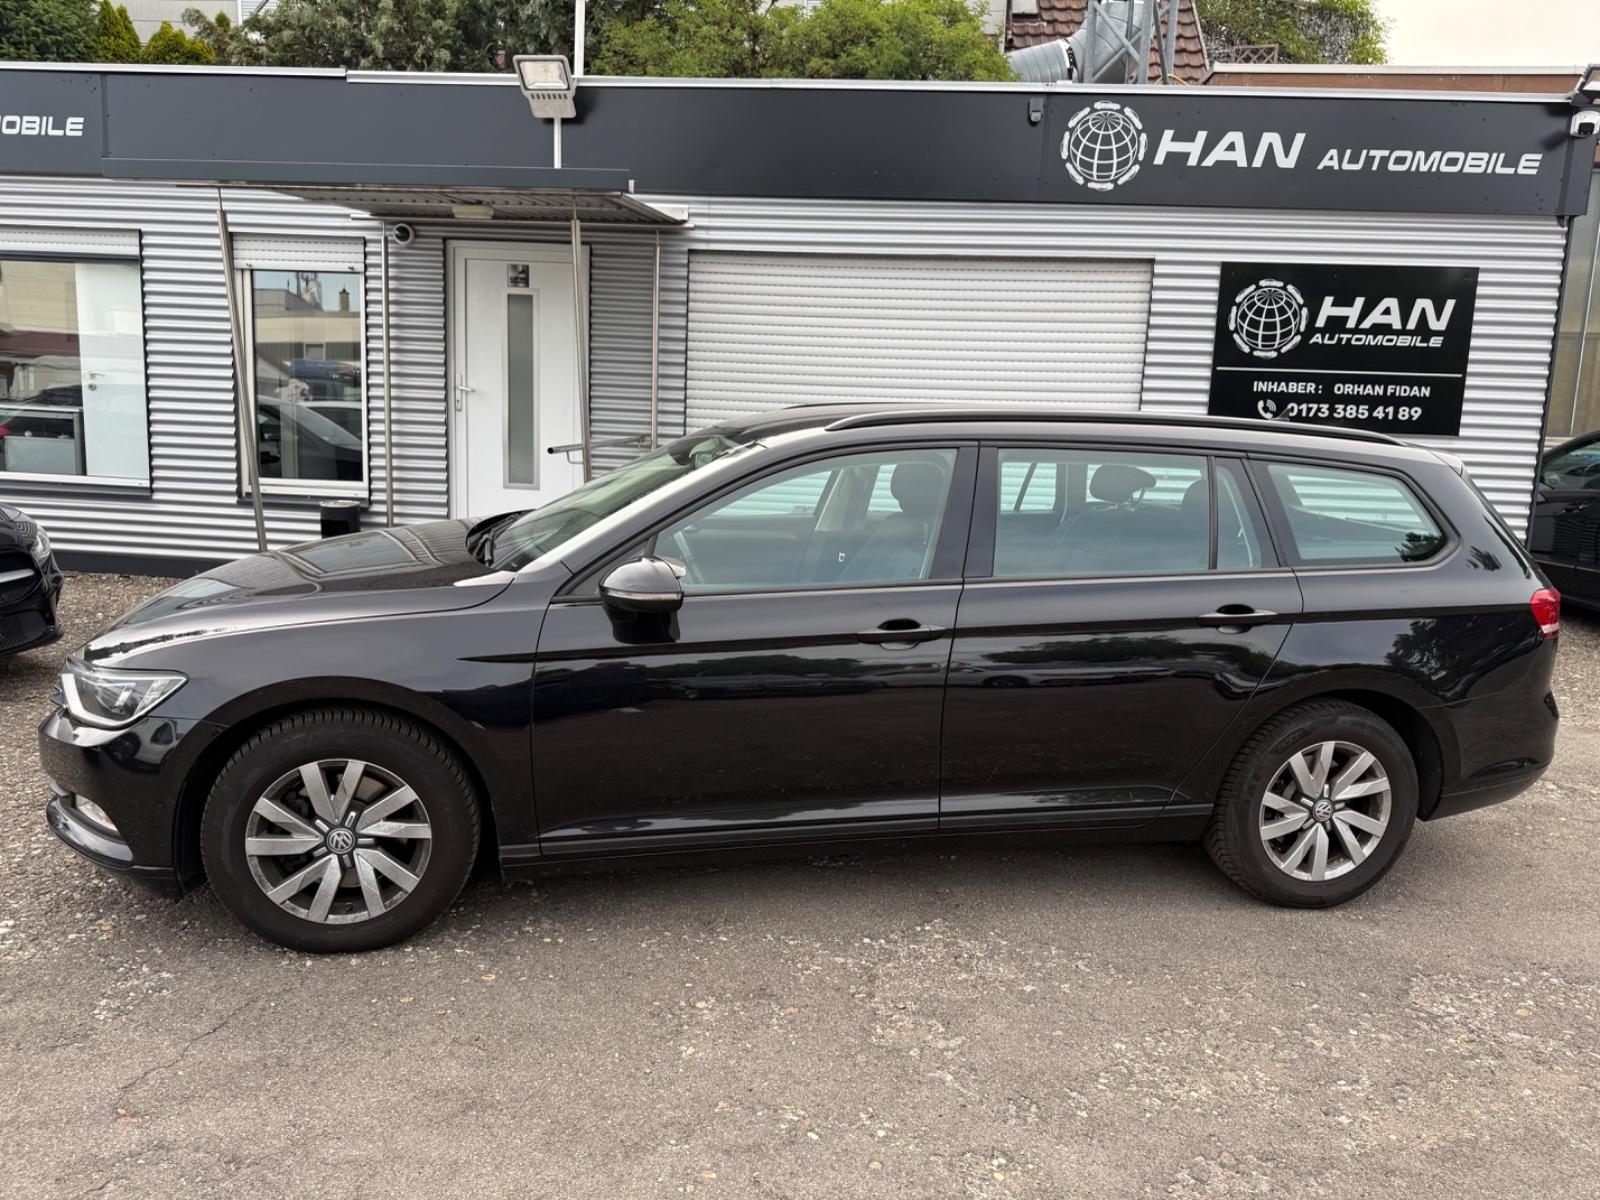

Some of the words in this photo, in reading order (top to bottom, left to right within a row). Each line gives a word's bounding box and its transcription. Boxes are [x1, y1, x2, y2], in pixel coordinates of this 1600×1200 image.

[0, 115, 85, 137] OBILE
[1153, 129, 1306, 169] HAN
[1316, 148, 1543, 175] AUTOMOBILE
[1314, 296, 1457, 331] HAN
[1309, 333, 1444, 347] AUTOMOBILE
[1334, 383, 1384, 396] ORHAN
[1387, 385, 1431, 398] FIDAN
[1287, 402, 1330, 418] 0173
[1333, 404, 1369, 419] 385
[1372, 405, 1395, 420] 41
[1397, 406, 1423, 421] 89
